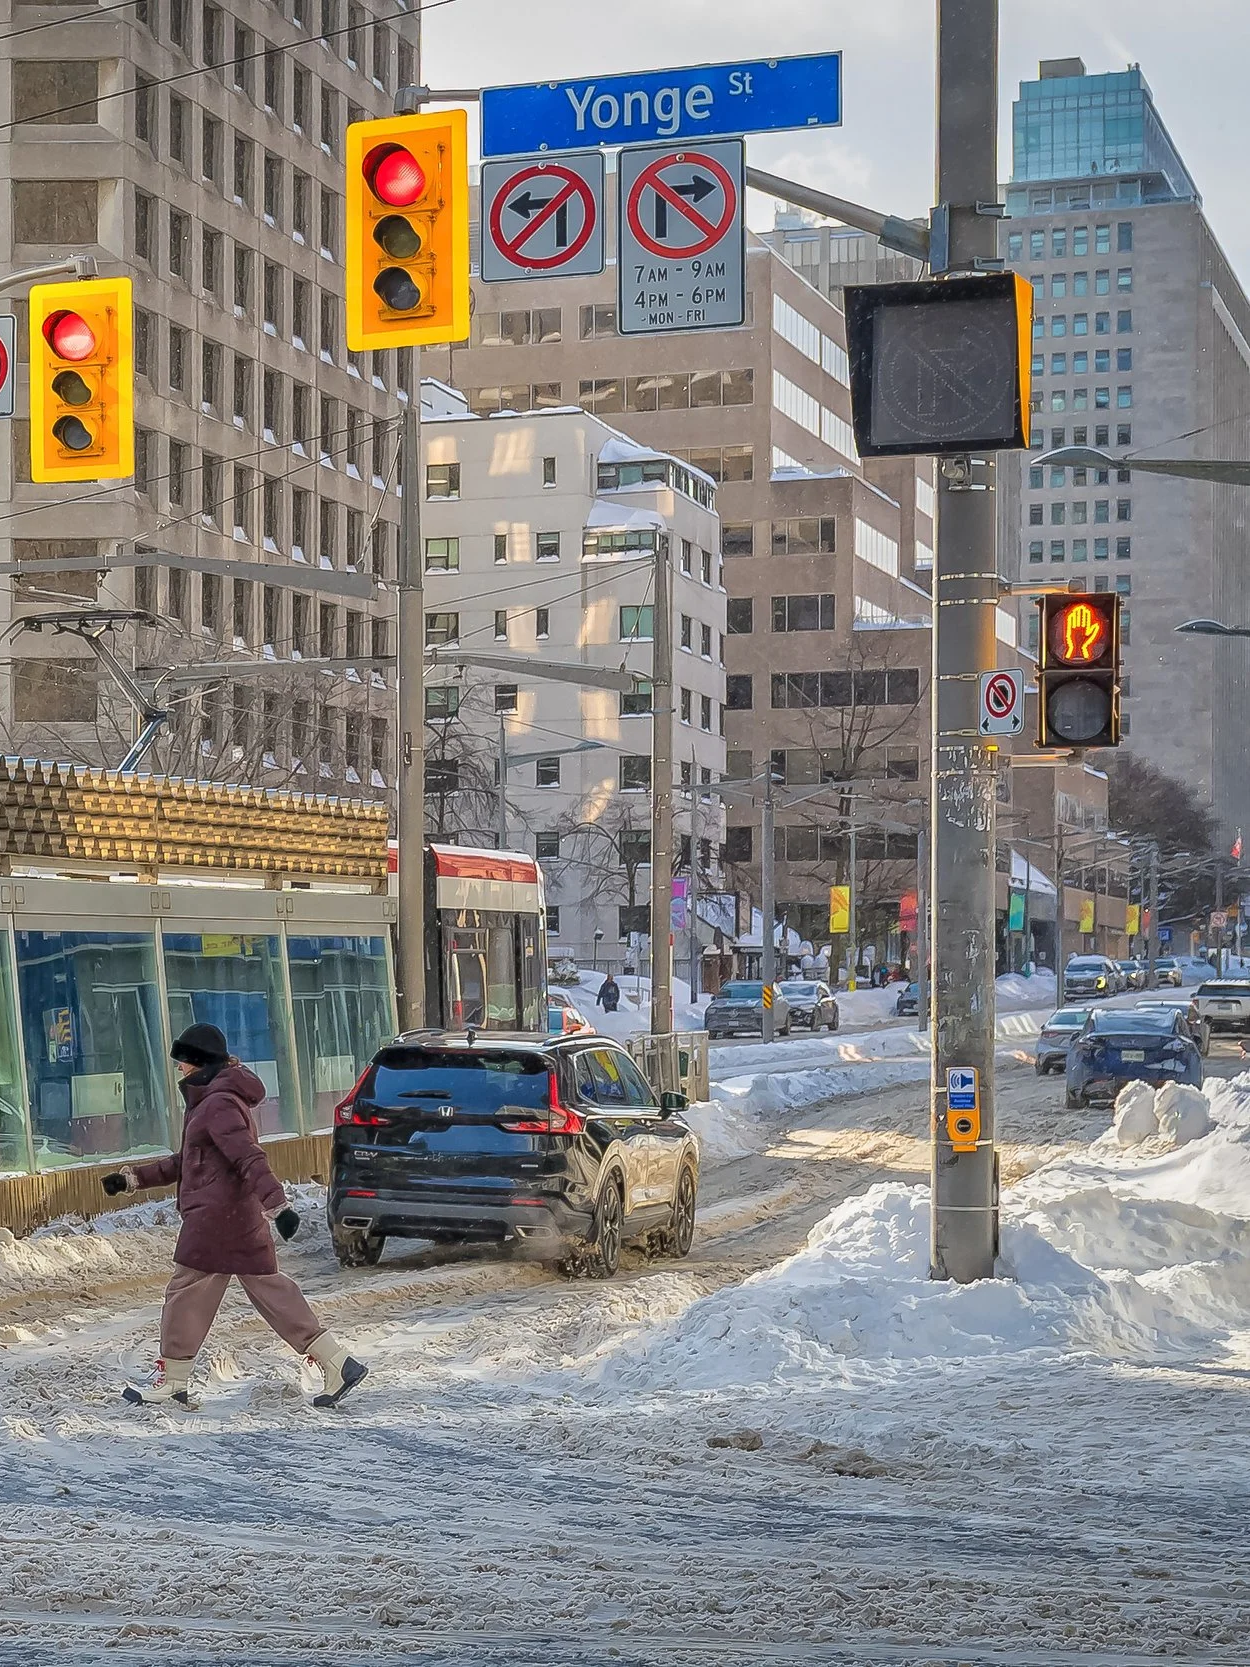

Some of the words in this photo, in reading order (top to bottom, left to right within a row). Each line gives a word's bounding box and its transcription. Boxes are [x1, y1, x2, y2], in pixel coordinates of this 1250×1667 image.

[565, 84, 714, 135] Yonge
[728, 72, 754, 96] St
[687, 309, 706, 322] FRI
